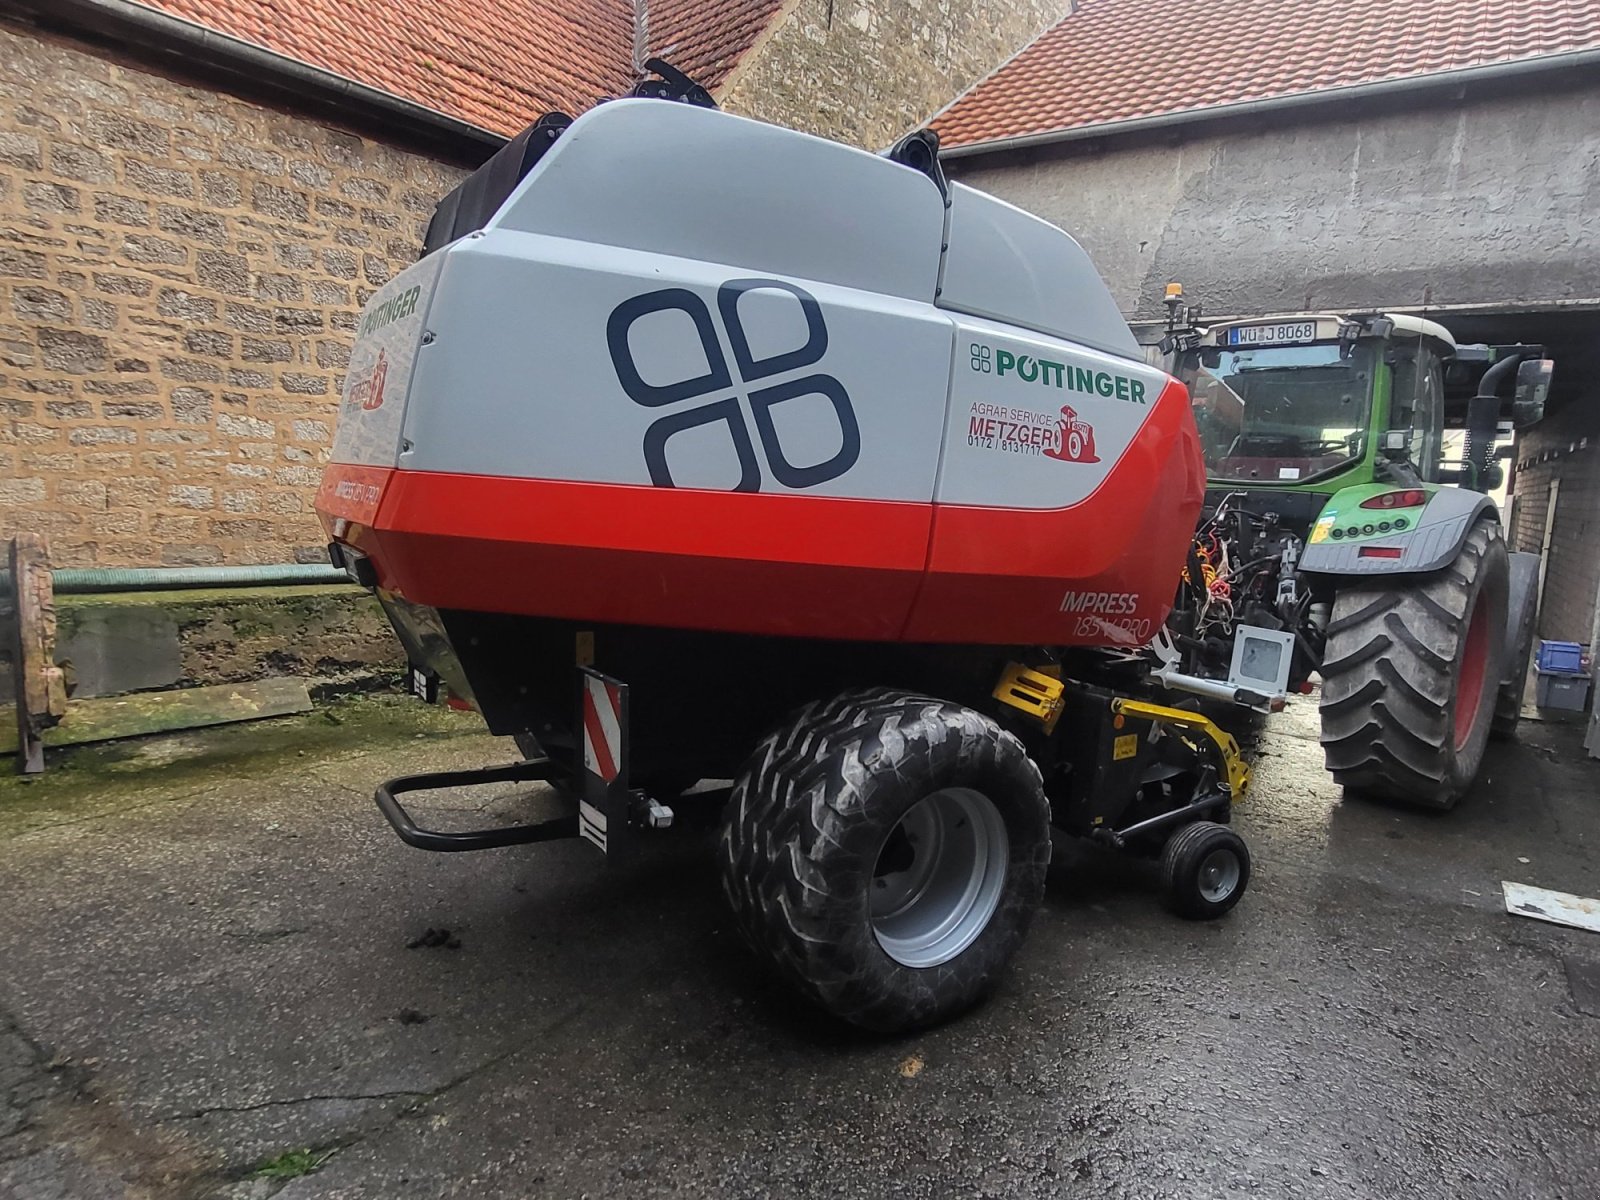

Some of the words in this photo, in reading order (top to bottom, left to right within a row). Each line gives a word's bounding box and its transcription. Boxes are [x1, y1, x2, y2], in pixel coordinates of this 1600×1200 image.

[1240, 328, 1257, 343] WÜ
[1266, 327, 1275, 341] J
[1278, 324, 1313, 340] 8068
[970, 402, 1008, 418] AGRAR
[1010, 408, 1053, 426] SERVICE
[969, 416, 1053, 447] METZGER
[967, 435, 992, 449] 0172
[1002, 440, 1041, 457] 8131717
[1059, 591, 1139, 614] IMPRESS
